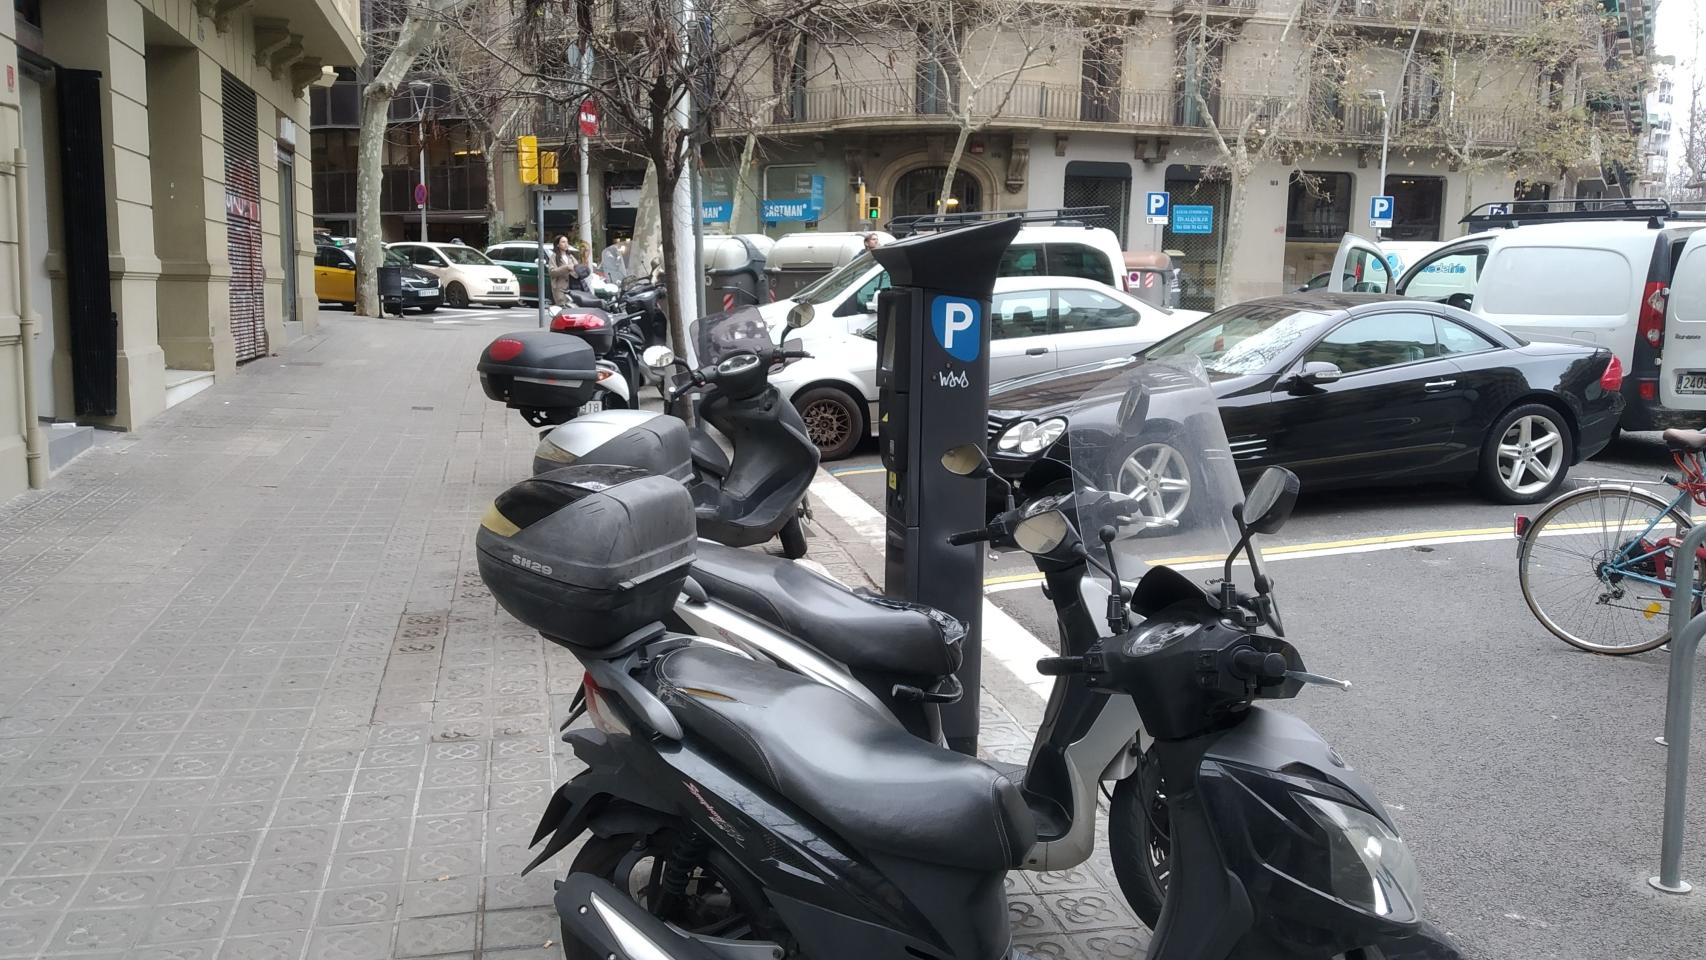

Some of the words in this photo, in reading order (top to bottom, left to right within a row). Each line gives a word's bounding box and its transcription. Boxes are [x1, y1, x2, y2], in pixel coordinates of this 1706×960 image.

[1150, 194, 1165, 214] P
[1374, 199, 1389, 218] P
[944, 302, 974, 349] P
[511, 554, 553, 575] SH29
